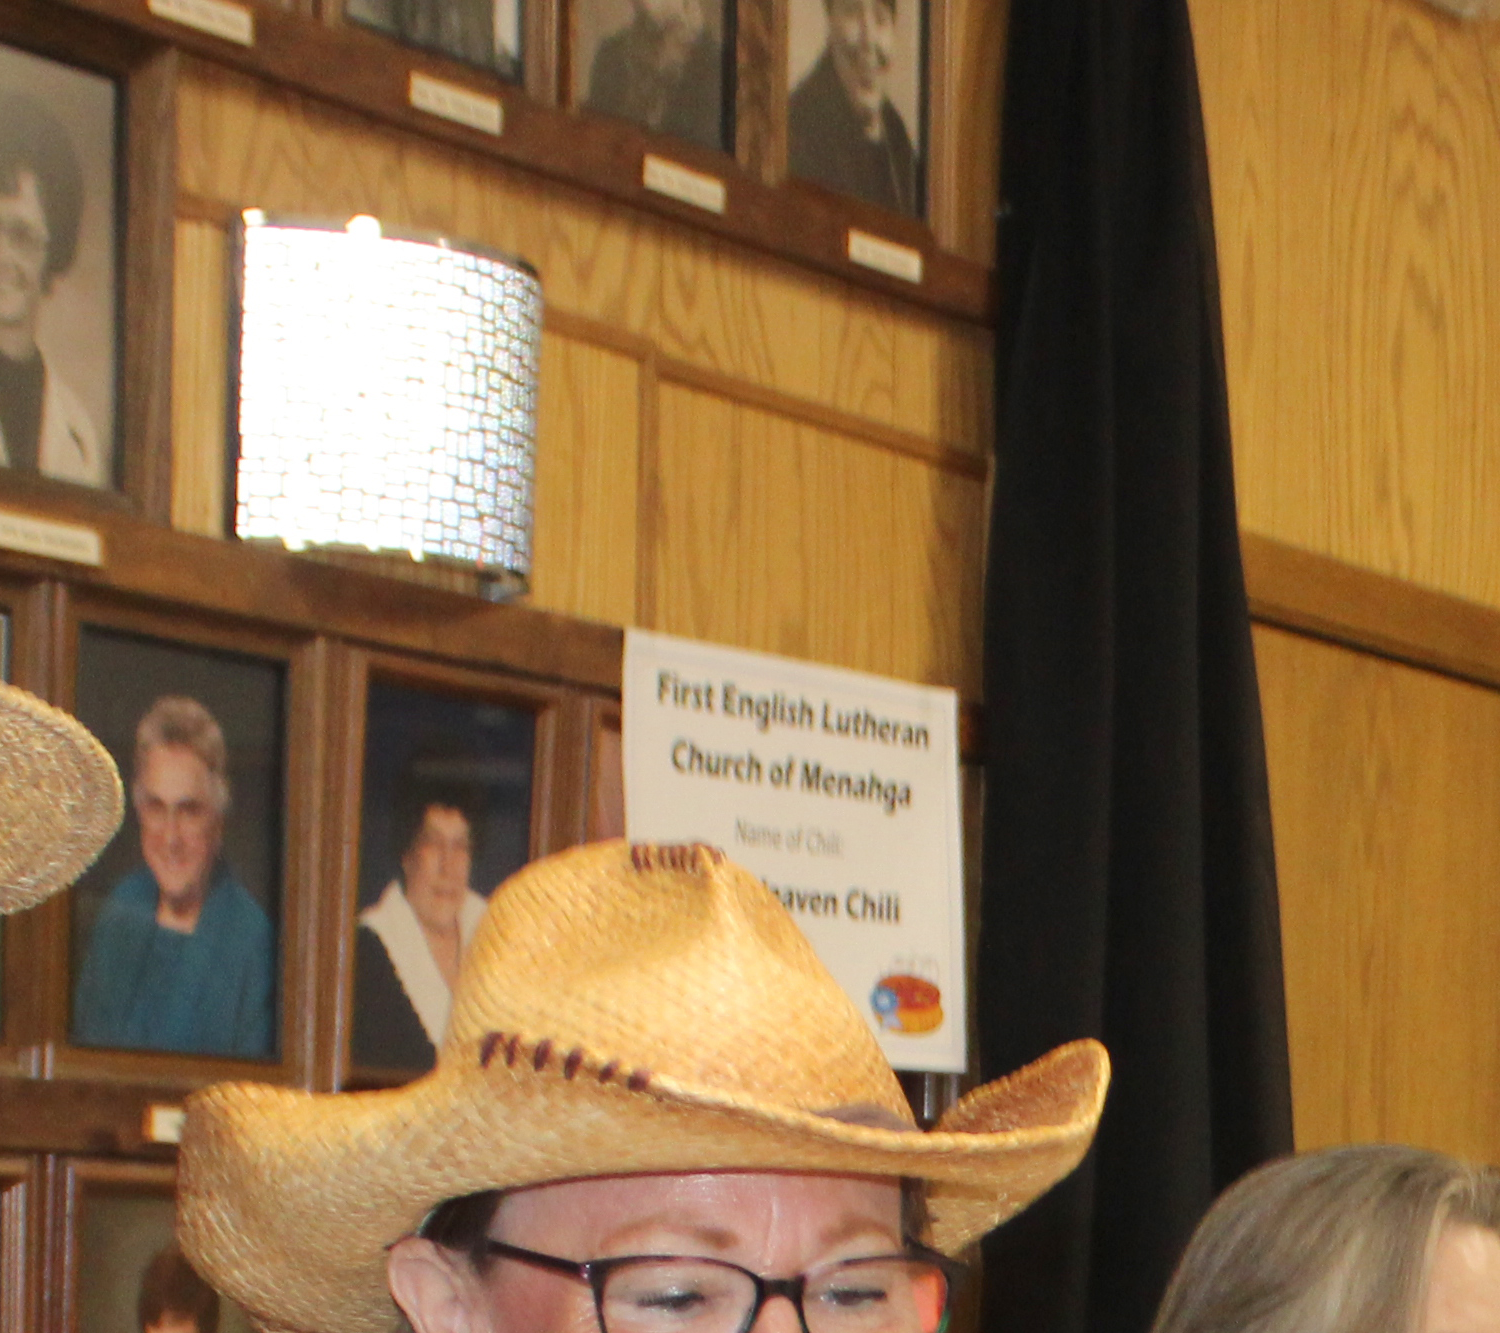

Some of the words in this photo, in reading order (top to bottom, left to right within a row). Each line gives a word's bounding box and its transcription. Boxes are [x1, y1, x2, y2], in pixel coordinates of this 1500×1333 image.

[656, 669, 714, 713] First
[721, 682, 814, 733] English
[820, 702, 930, 749] Lutheran
[671, 738, 762, 783] Church
[769, 755, 795, 787] of
[801, 760, 912, 815] Menahga
[845, 887, 902, 923] Chili
